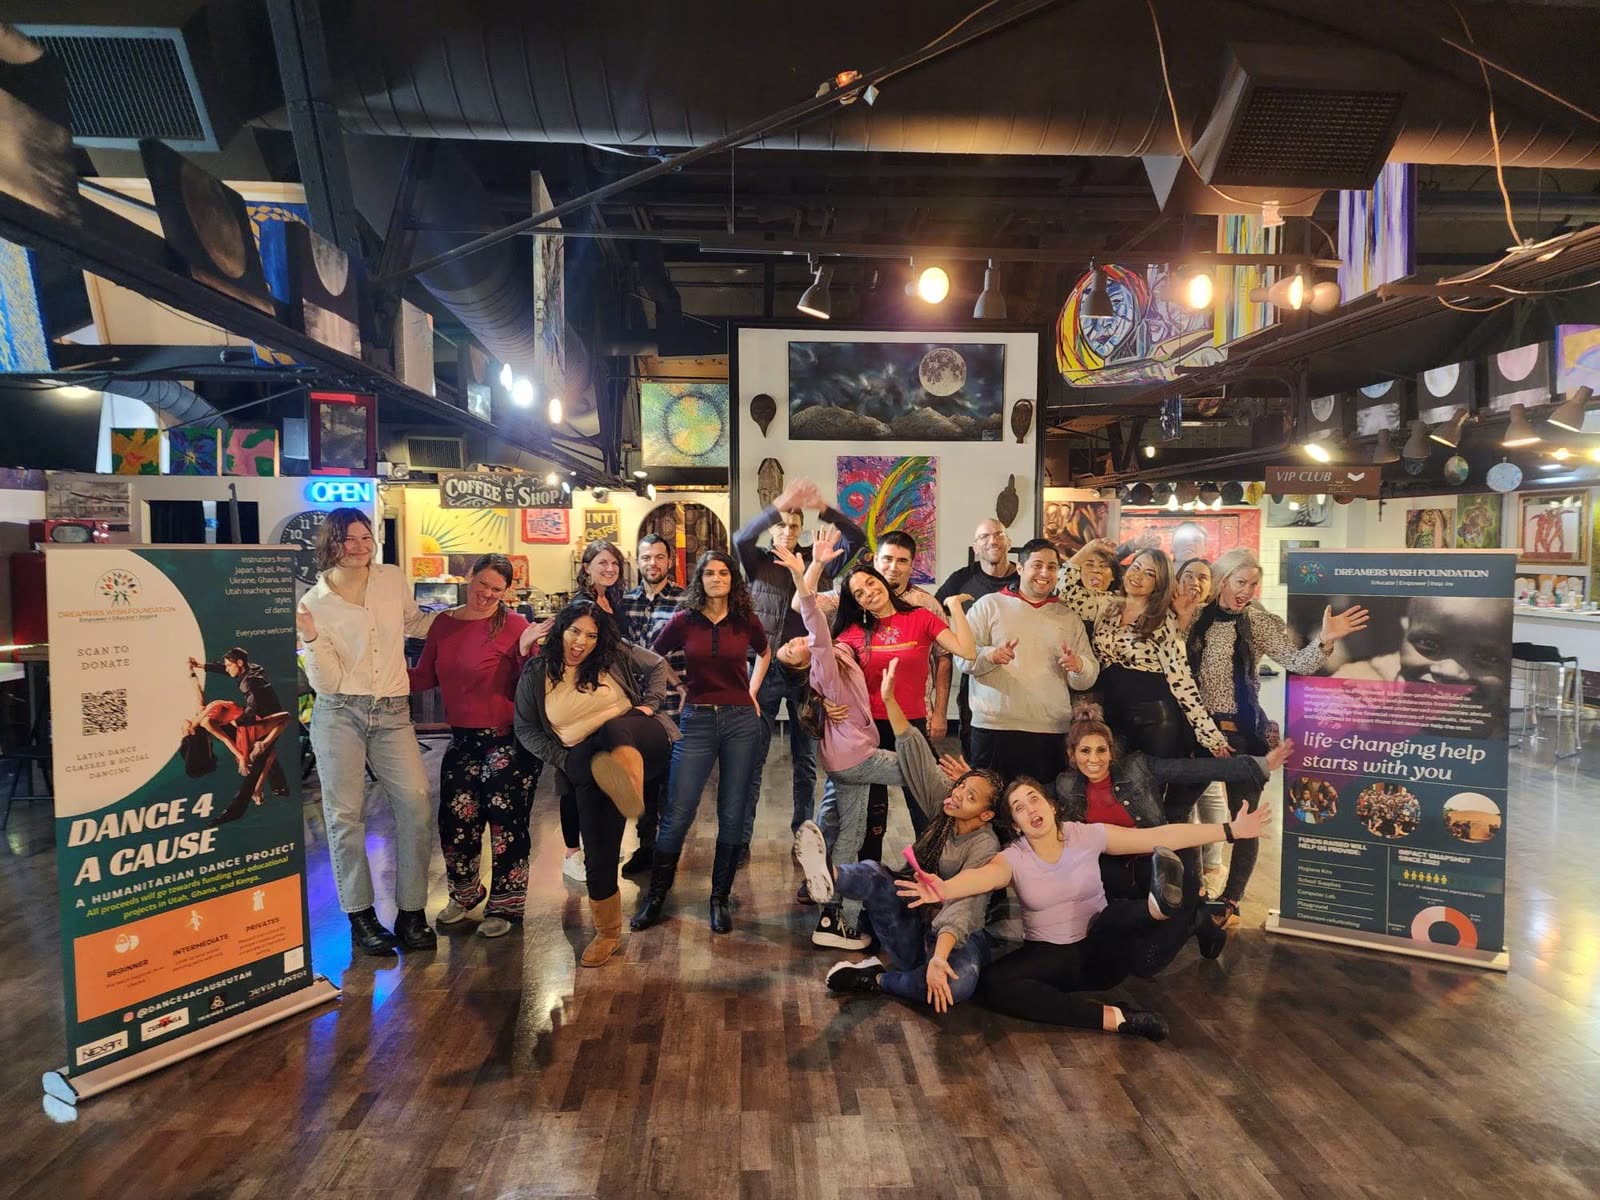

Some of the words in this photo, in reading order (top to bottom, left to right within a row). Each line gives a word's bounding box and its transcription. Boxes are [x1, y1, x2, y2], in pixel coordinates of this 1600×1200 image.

[1276, 471, 1296, 482] VIP
[1298, 471, 1332, 482] CLUB
[311, 482, 370, 502] OPEN
[445, 478, 501, 502] COFFEE
[586, 513, 618, 524] INTI
[241, 555, 276, 563] Instructors
[1334, 568, 1389, 577] DREAMERS
[1389, 568, 1417, 577] WISH
[1417, 568, 1489, 578] FOUNDATION
[225, 587, 242, 595] Utah
[242, 587, 270, 595] teaching
[57, 610, 105, 618] DREAMERS
[105, 608, 127, 616] WISH
[127, 606, 176, 615] FOUNDATION
[235, 629, 266, 638] Everyone
[77, 646, 110, 657] SCAN
[113, 645, 129, 654] TO
[81, 658, 130, 671] DONATE
[76, 751, 105, 761] LATIN
[107, 745, 137, 756] DANCE
[1303, 731, 1437, 761] life-changing
[1440, 740, 1487, 765] help
[65, 760, 106, 773] CLASSES
[119, 753, 149, 764] SOCIAL
[1302, 754, 1358, 771] starts
[1362, 759, 1408, 776] with
[1409, 766, 1452, 782] you
[88, 766, 131, 780] DANCING
[67, 797, 188, 847] DANCE
[191, 792, 214, 818] 4
[1298, 836, 1322, 845] FUNDS
[1323, 839, 1349, 848] RAISED
[1349, 843, 1368, 851] WILL
[1298, 842, 1317, 850] HELP
[1316, 844, 1328, 852] US
[73, 856, 101, 887] A
[109, 827, 219, 876] CAUSE
[1397, 849, 1427, 858] IMPACT
[1427, 852, 1472, 864] SNAPSHOT
[1397, 855, 1421, 863] SINCE
[75, 898, 86, 908] A
[91, 869, 195, 904] HUMANITARIAN
[199, 856, 241, 875] DANCE
[245, 842, 296, 863] PROJECT
[1297, 865, 1321, 873] Hygiene
[86, 907, 99, 918] All
[101, 897, 140, 916] proceeds
[140, 892, 156, 902] will
[156, 890, 167, 899] go
[168, 879, 201, 894] towards
[201, 871, 232, 884] funding
[232, 868, 246, 876] our
[247, 855, 289, 872] educational
[1297, 877, 1317, 885] School
[1317, 880, 1342, 888] Supplies
[123, 902, 157, 920] projects
[158, 899, 167, 908] in
[219, 880, 235, 891] and
[1297, 888, 1325, 898] Computer
[1297, 900, 1329, 911] Playground
[1296, 912, 1326, 922] Classroom
[245, 916, 280, 933] PRIVATES
[172, 933, 229, 956] INTERMEDIATE
[106, 959, 149, 978] BEGINNER
